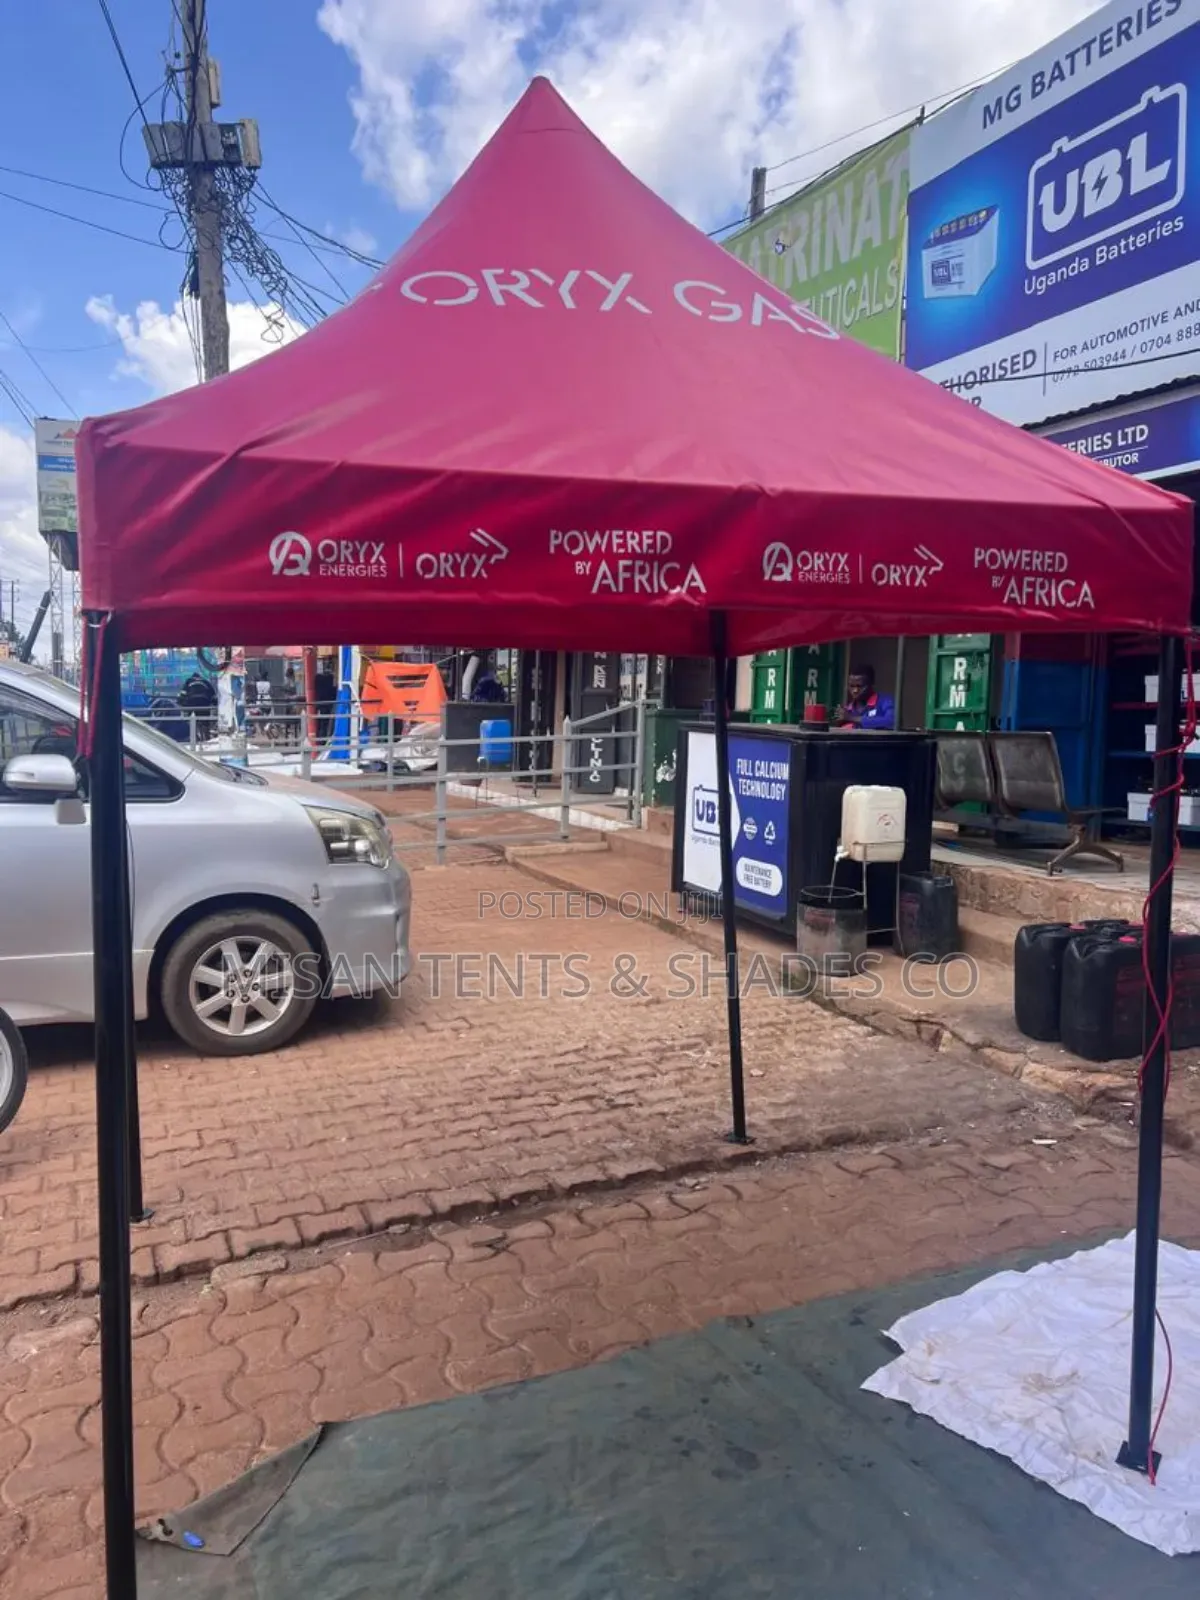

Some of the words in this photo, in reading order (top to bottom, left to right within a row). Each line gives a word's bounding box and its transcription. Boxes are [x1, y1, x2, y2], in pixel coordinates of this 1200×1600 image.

[982, 84, 1022, 130] MG
[1030, 0, 1182, 100] BATTERIES
[1038, 131, 1173, 233] UBL
[1024, 257, 1090, 296] Uganda
[1095, 215, 1185, 266] Batteries
[400, 268, 653, 315] ORYX
[672, 280, 840, 339] GAS
[1053, 345, 1077, 363] FOR
[1080, 310, 1168, 354] AUTOMOTIVE
[1140, 333, 1171, 354] 0704
[1117, 424, 1149, 447] LTD
[317, 538, 386, 564] ORYX
[415, 552, 488, 579] ORYX
[548, 529, 673, 555] POWERED
[318, 563, 388, 578] ENERGIES
[796, 550, 850, 572] ORYX
[871, 562, 928, 587] ORYX
[974, 546, 1069, 573] POWERED
[574, 560, 592, 575] BY
[590, 558, 708, 595] AFRICA
[798, 571, 851, 585] ENERGIES
[1002, 575, 1096, 609] AFRICA
[736, 757, 753, 776] FULL
[755, 760, 789, 780] CALCIUM
[738, 778, 787, 801] TECHNOLOGY
